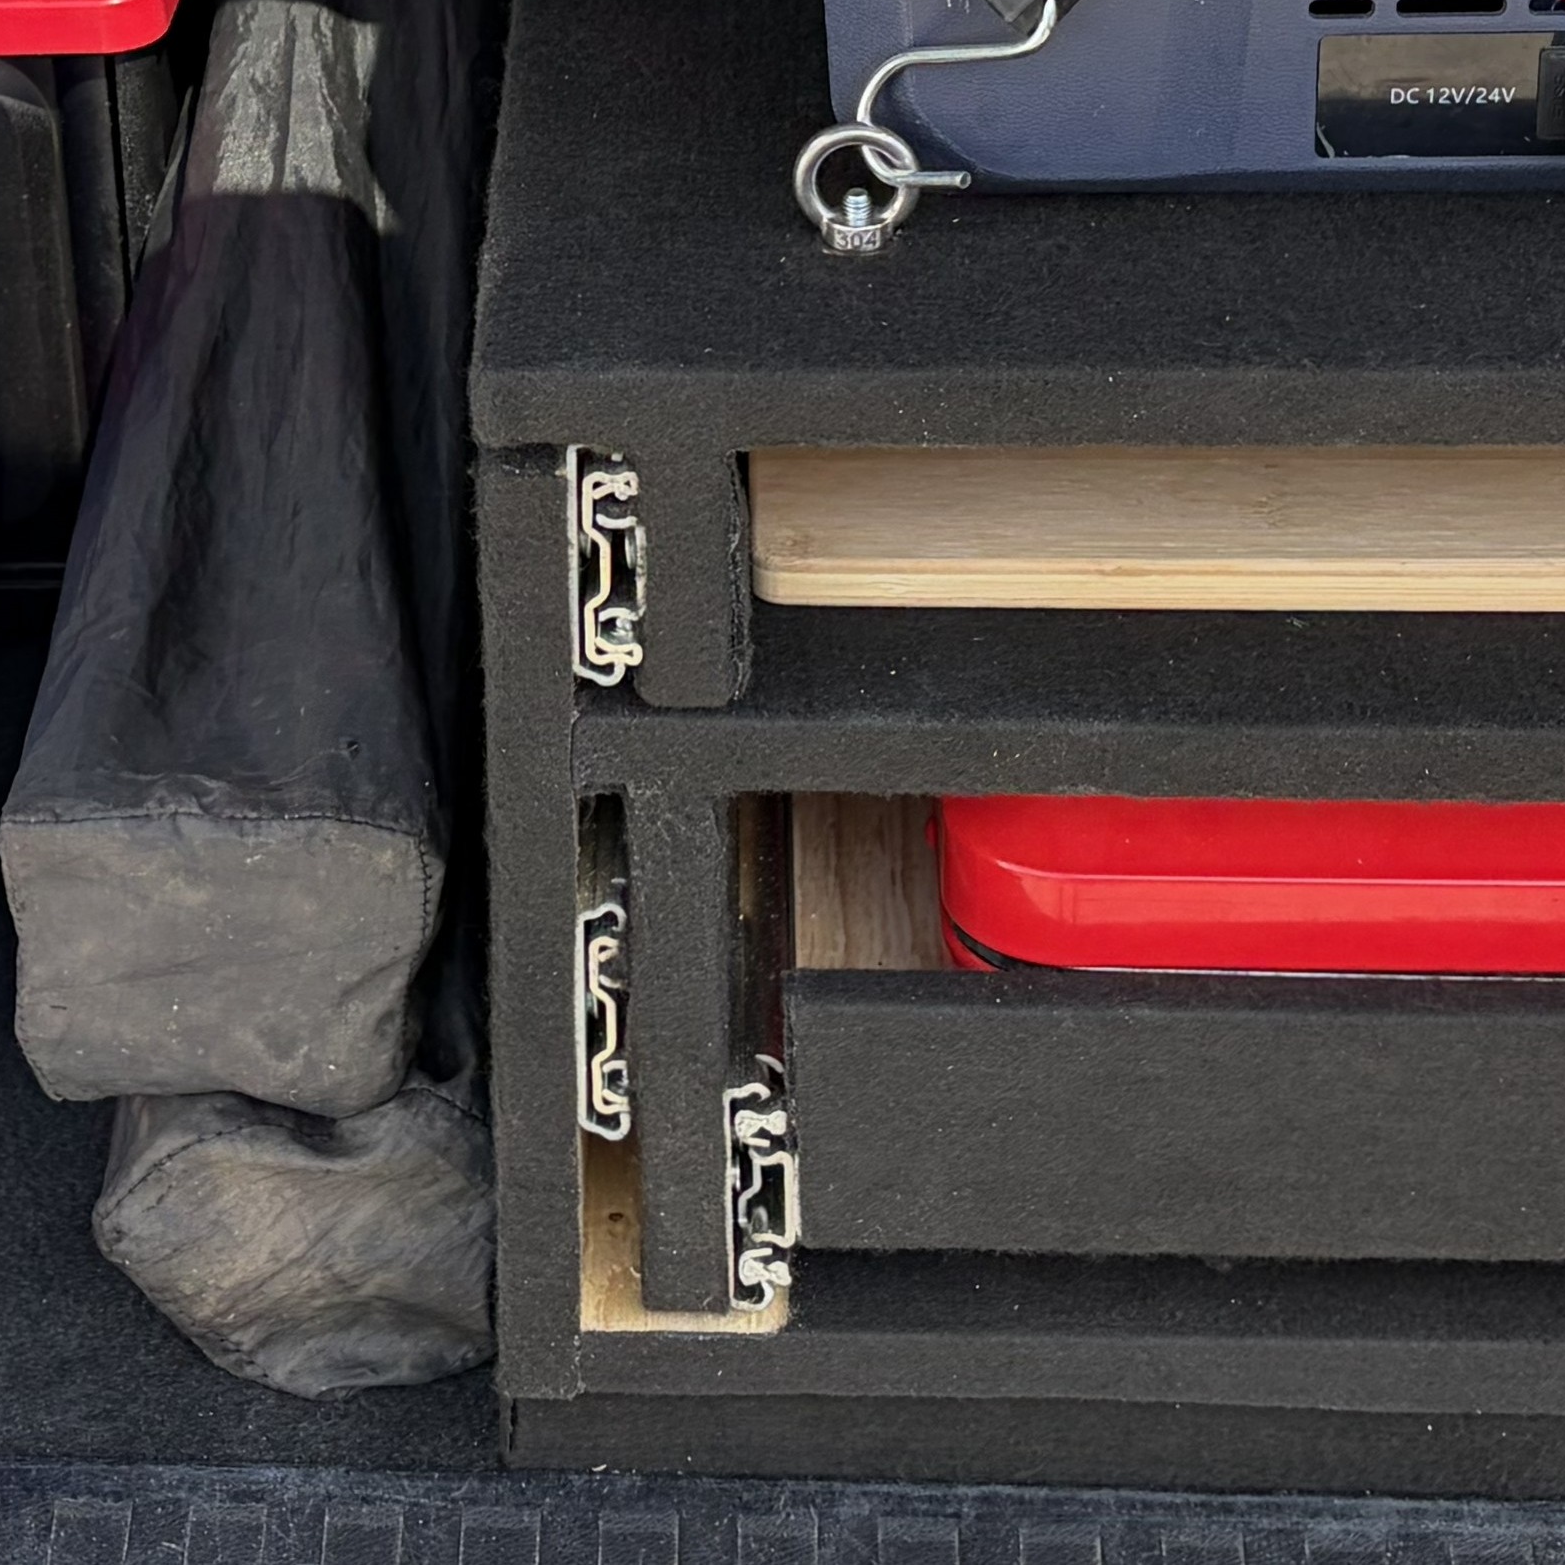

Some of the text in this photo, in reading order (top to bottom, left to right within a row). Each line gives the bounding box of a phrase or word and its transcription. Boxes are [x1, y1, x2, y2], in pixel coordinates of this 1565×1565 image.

[1390, 85, 1516, 105] DC 12V/24V
[835, 229, 877, 249] 304
